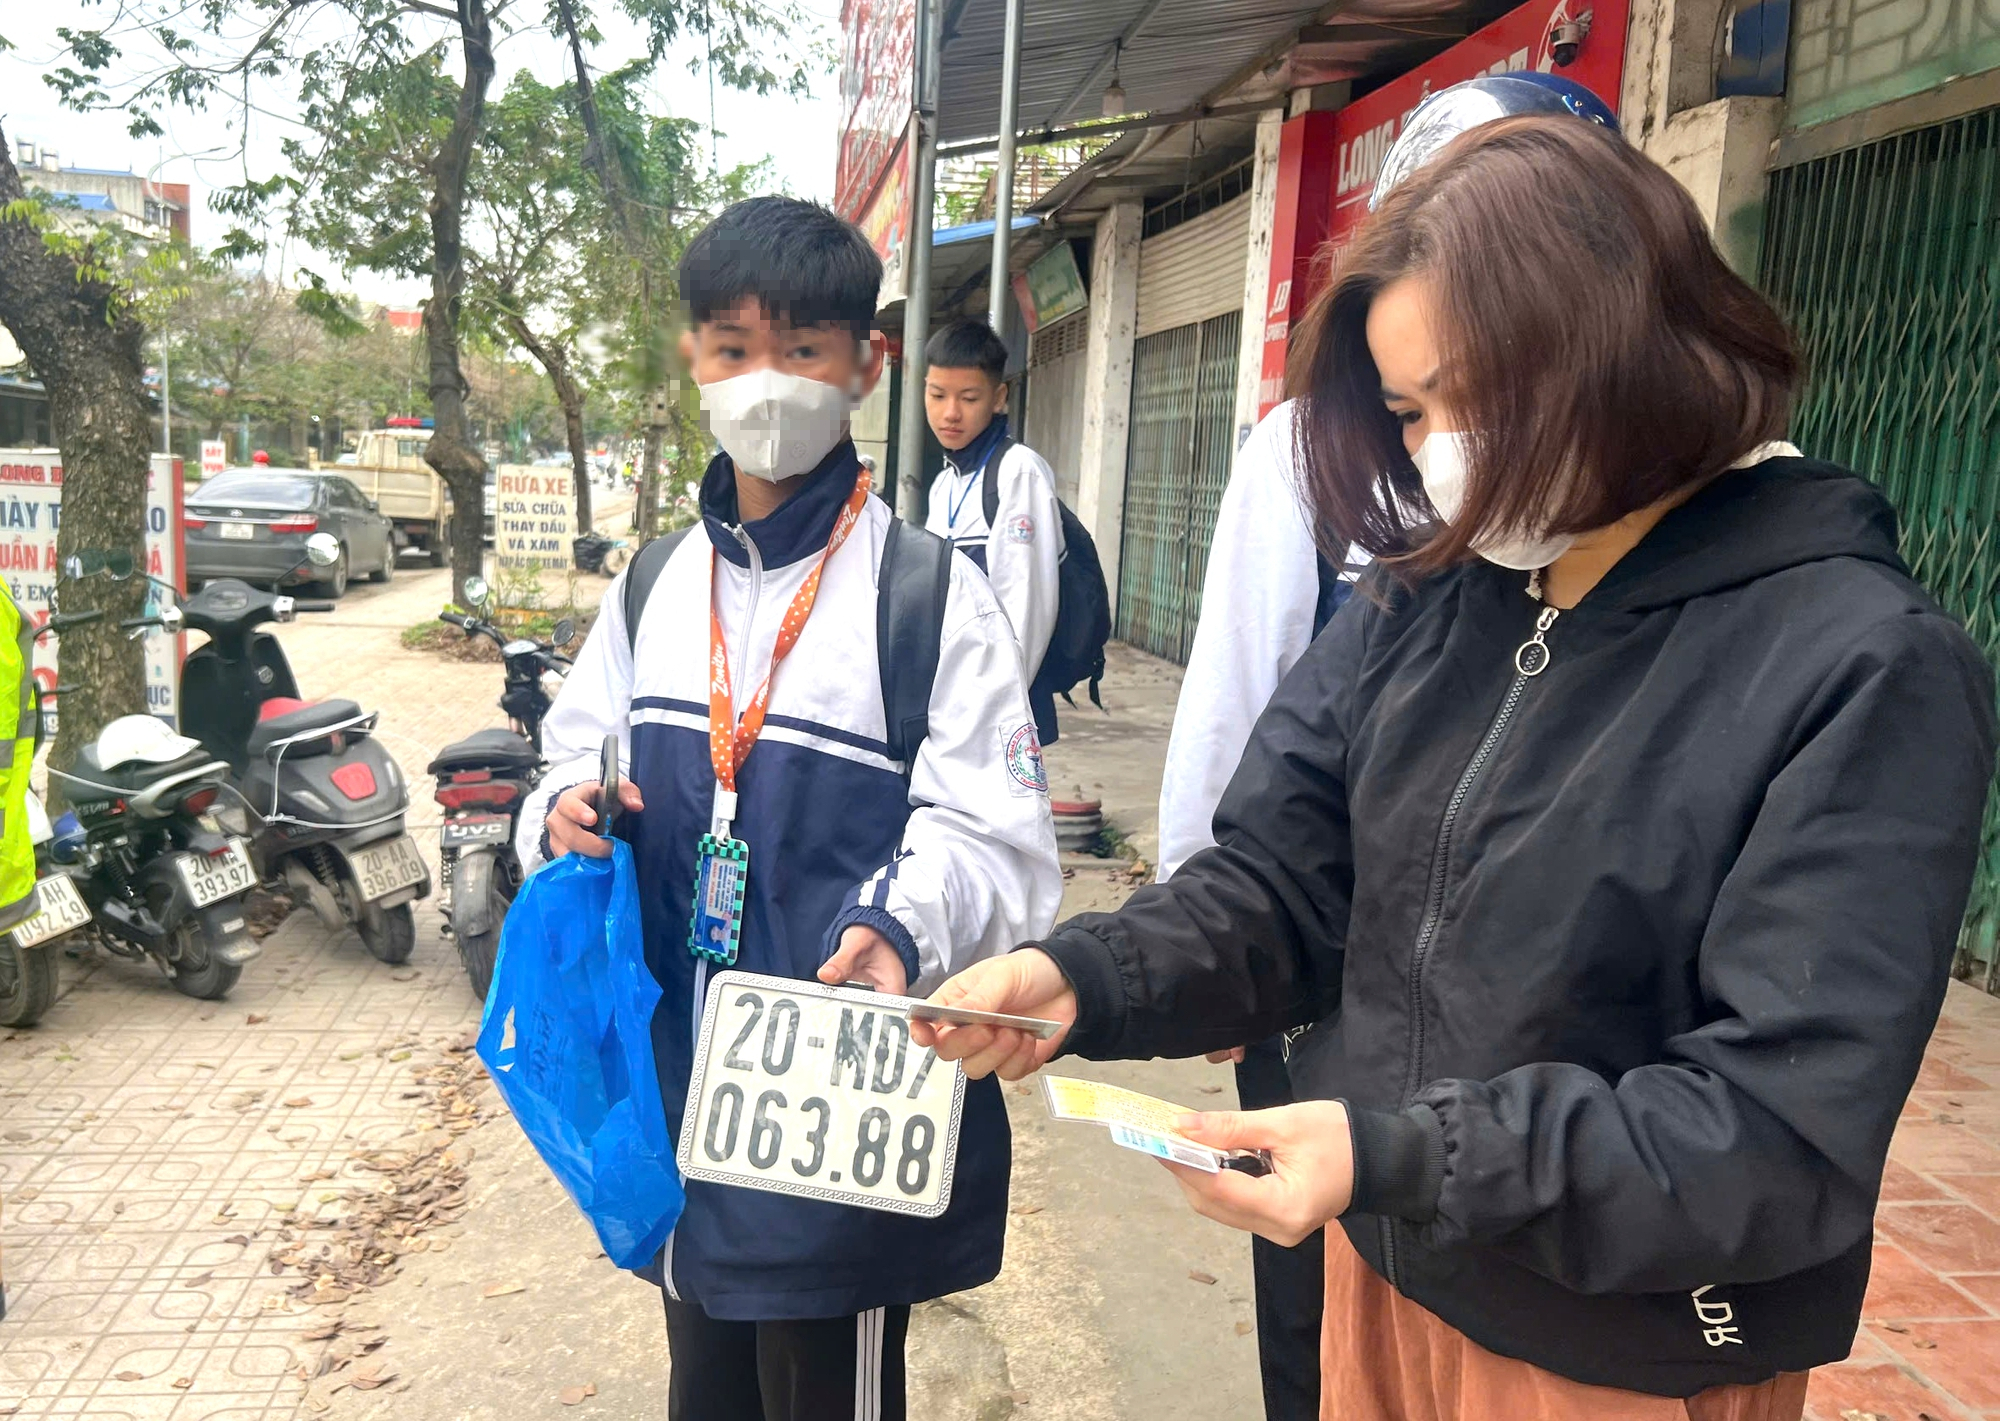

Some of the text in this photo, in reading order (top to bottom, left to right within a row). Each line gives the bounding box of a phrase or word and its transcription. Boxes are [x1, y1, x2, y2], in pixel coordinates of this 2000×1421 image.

[0, 464, 45, 482] ONG
[544, 478, 567, 495] XE
[503, 519, 535, 532] THAY
[711, 641, 729, 698] Zenitsu
[452, 823, 503, 837] JVC
[194, 863, 249, 901] 393.97
[363, 860, 421, 896] 396.09
[41, 880, 68, 906] AH
[703, 1081, 936, 1196] 063.88
